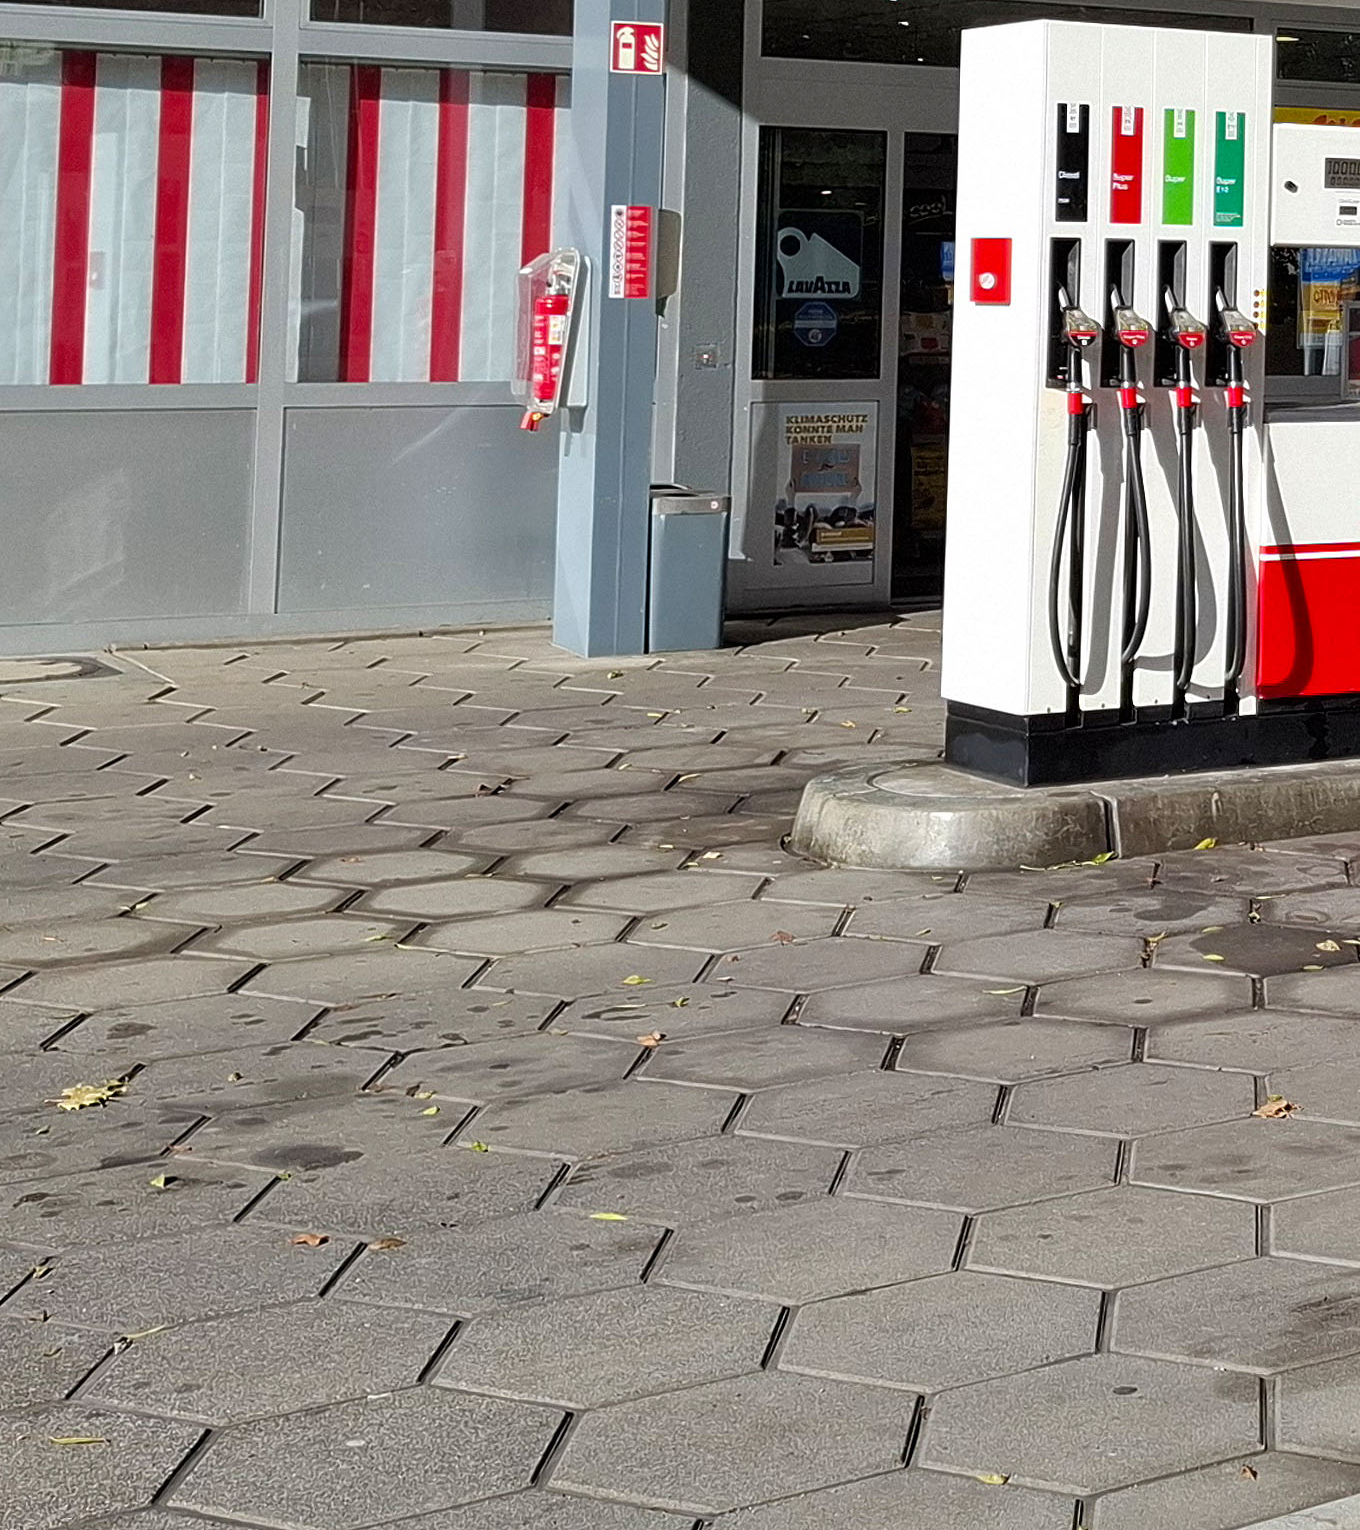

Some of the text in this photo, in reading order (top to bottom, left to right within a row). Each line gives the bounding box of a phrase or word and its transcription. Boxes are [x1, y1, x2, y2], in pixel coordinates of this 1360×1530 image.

[787, 275, 852, 295] LAVAZZA
[786, 414, 868, 424] KLIMASCHUTZ
[836, 424, 864, 434] MAN
[785, 435, 832, 445] TANKEN
